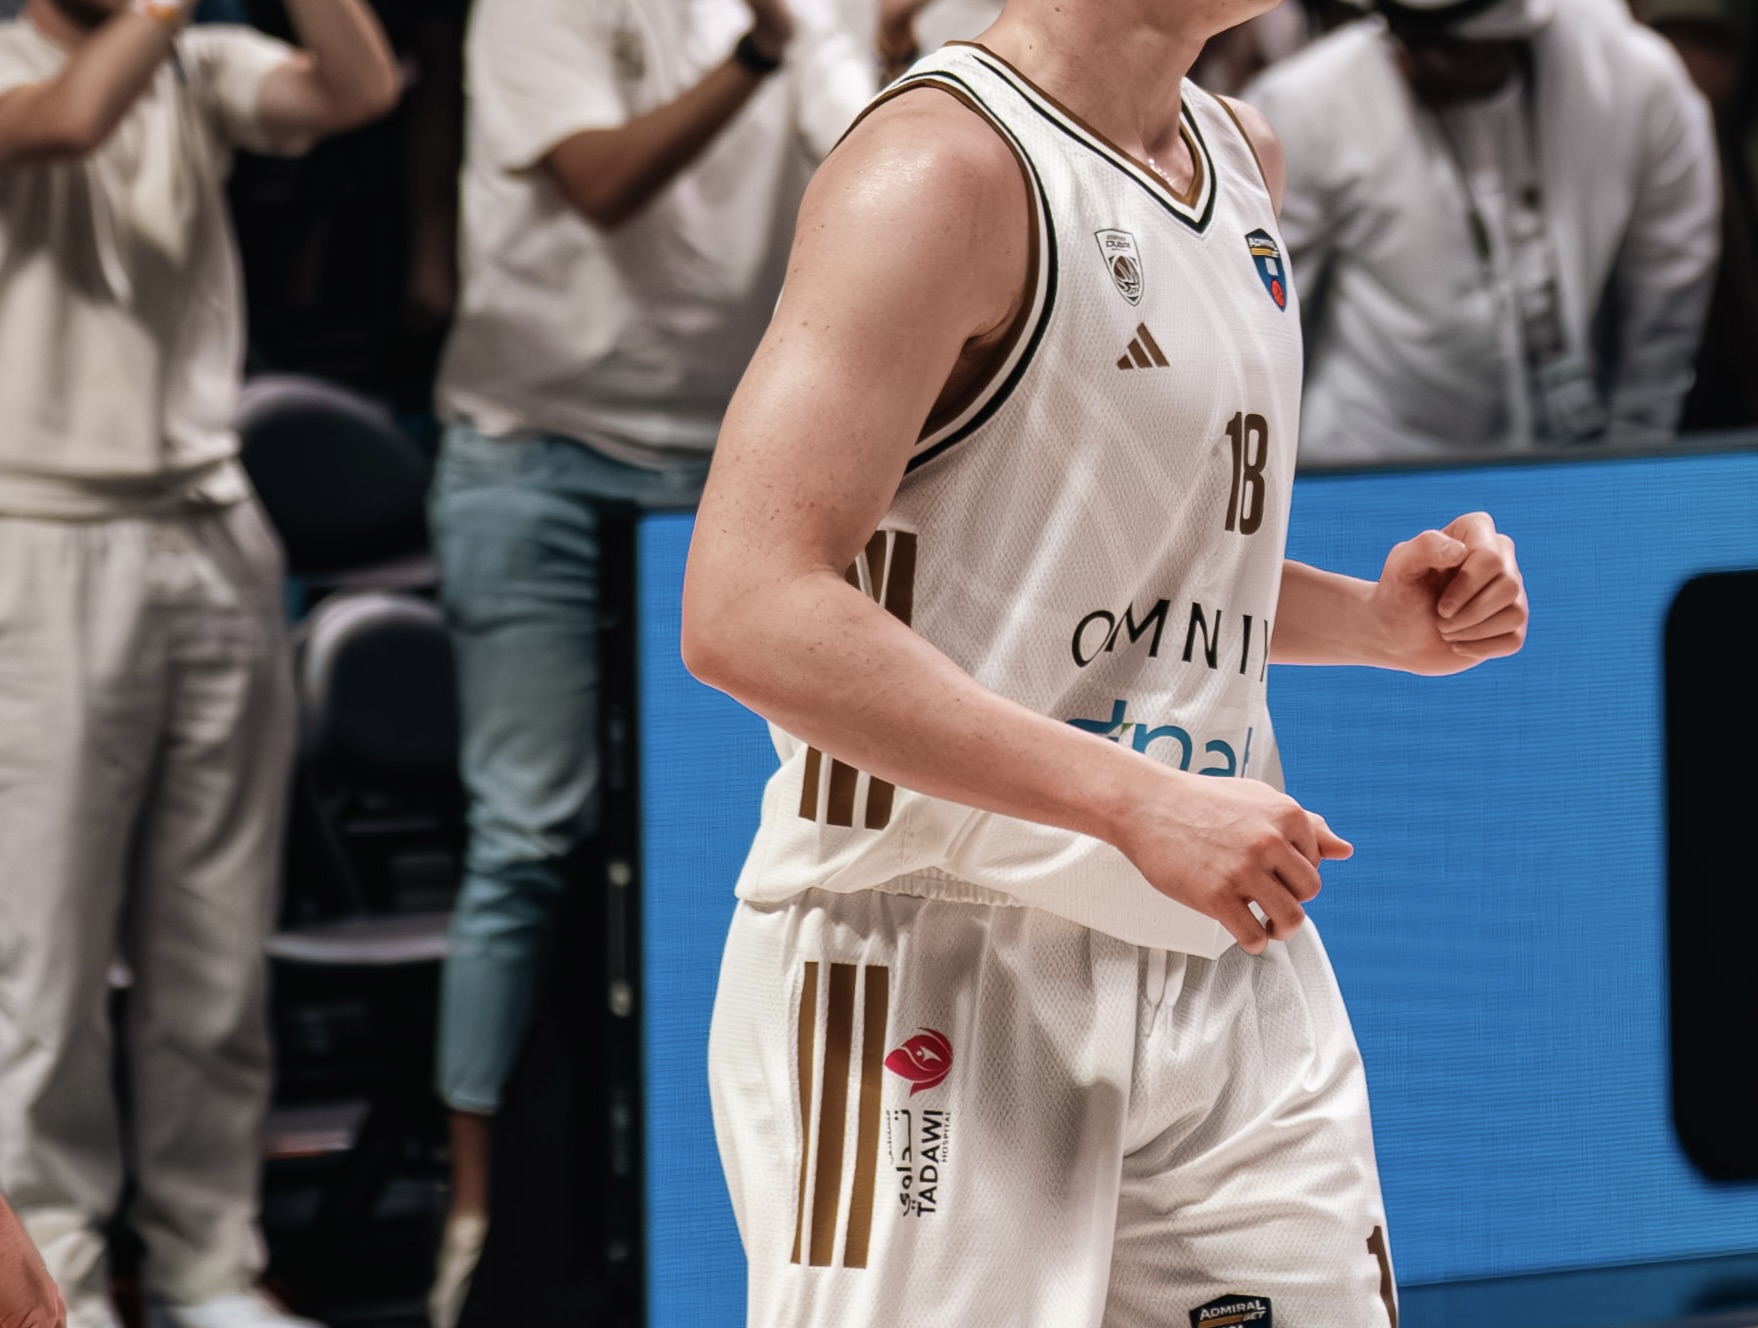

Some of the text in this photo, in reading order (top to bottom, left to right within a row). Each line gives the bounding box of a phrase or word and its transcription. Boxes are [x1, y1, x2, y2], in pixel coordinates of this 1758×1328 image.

[1224, 411, 1268, 535] 18
[1072, 599, 1269, 682] OMNI
[916, 1109, 944, 1217] TADAWI
[941, 1112, 951, 1162] HOSPITAL
[1200, 1300, 1266, 1320] ADMIRAL
